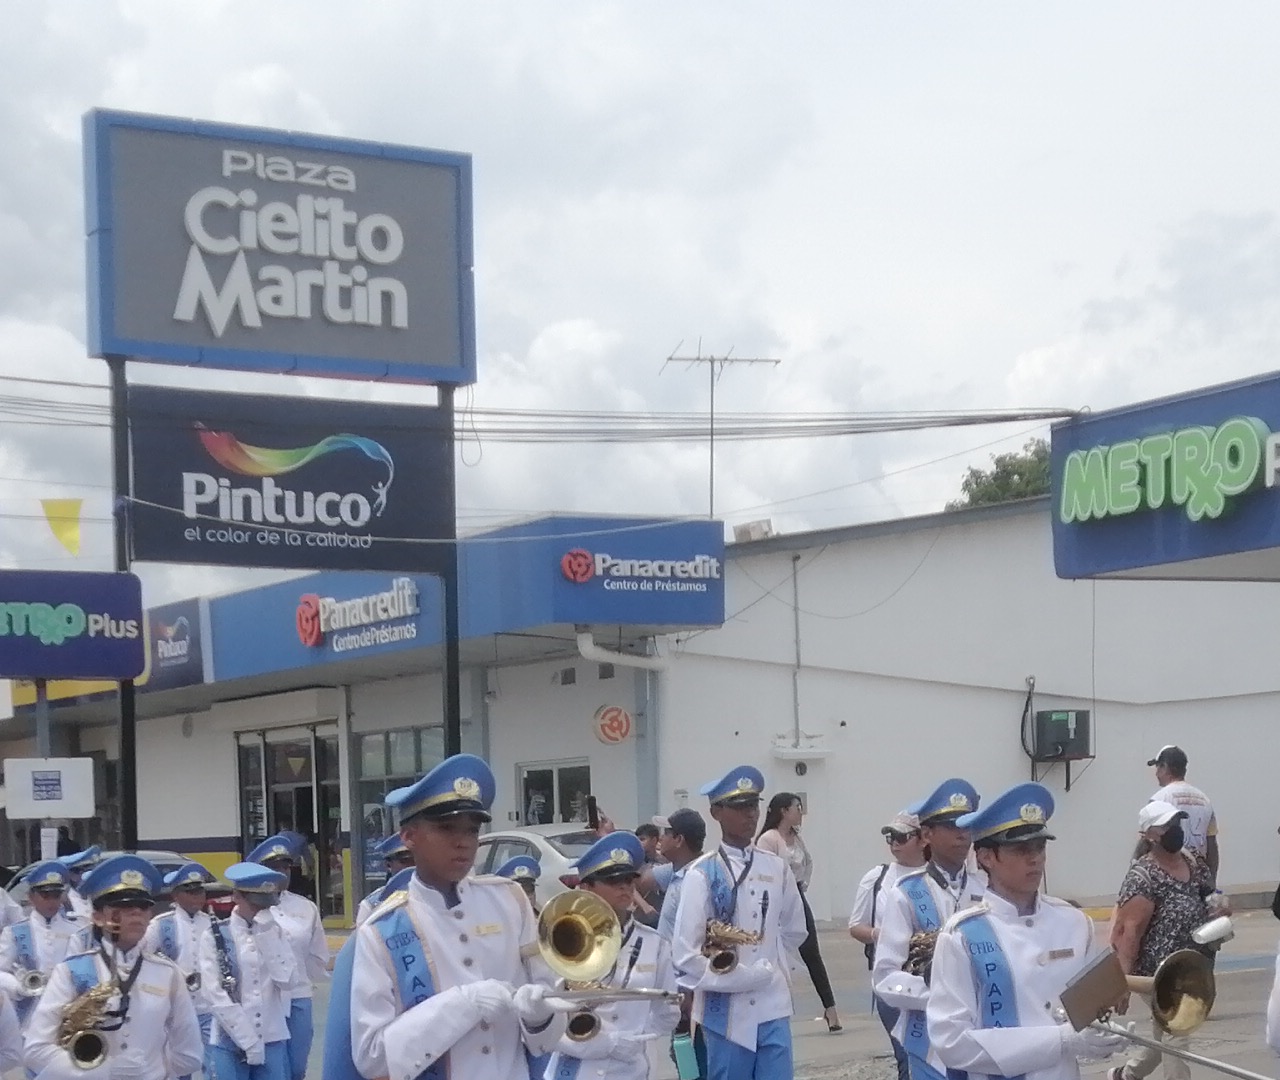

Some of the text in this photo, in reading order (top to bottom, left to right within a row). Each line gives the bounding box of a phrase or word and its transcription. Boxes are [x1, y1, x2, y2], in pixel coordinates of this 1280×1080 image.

[222, 149, 357, 193] Plaza
[183, 185, 405, 266] Cielito
[173, 243, 409, 338] Martin
[1060, 415, 1267, 523] METRO
[182, 471, 371, 527] Pintuco
[184, 526, 372, 549] el color de la calidad
[594, 552, 720, 579] Panacredit
[603, 578, 707, 592] Centro de Préstamos
[88, 613, 140, 639] Plus
[320, 577, 420, 632] Panacredit
[332, 622, 417, 652] Centro de Préstamos
